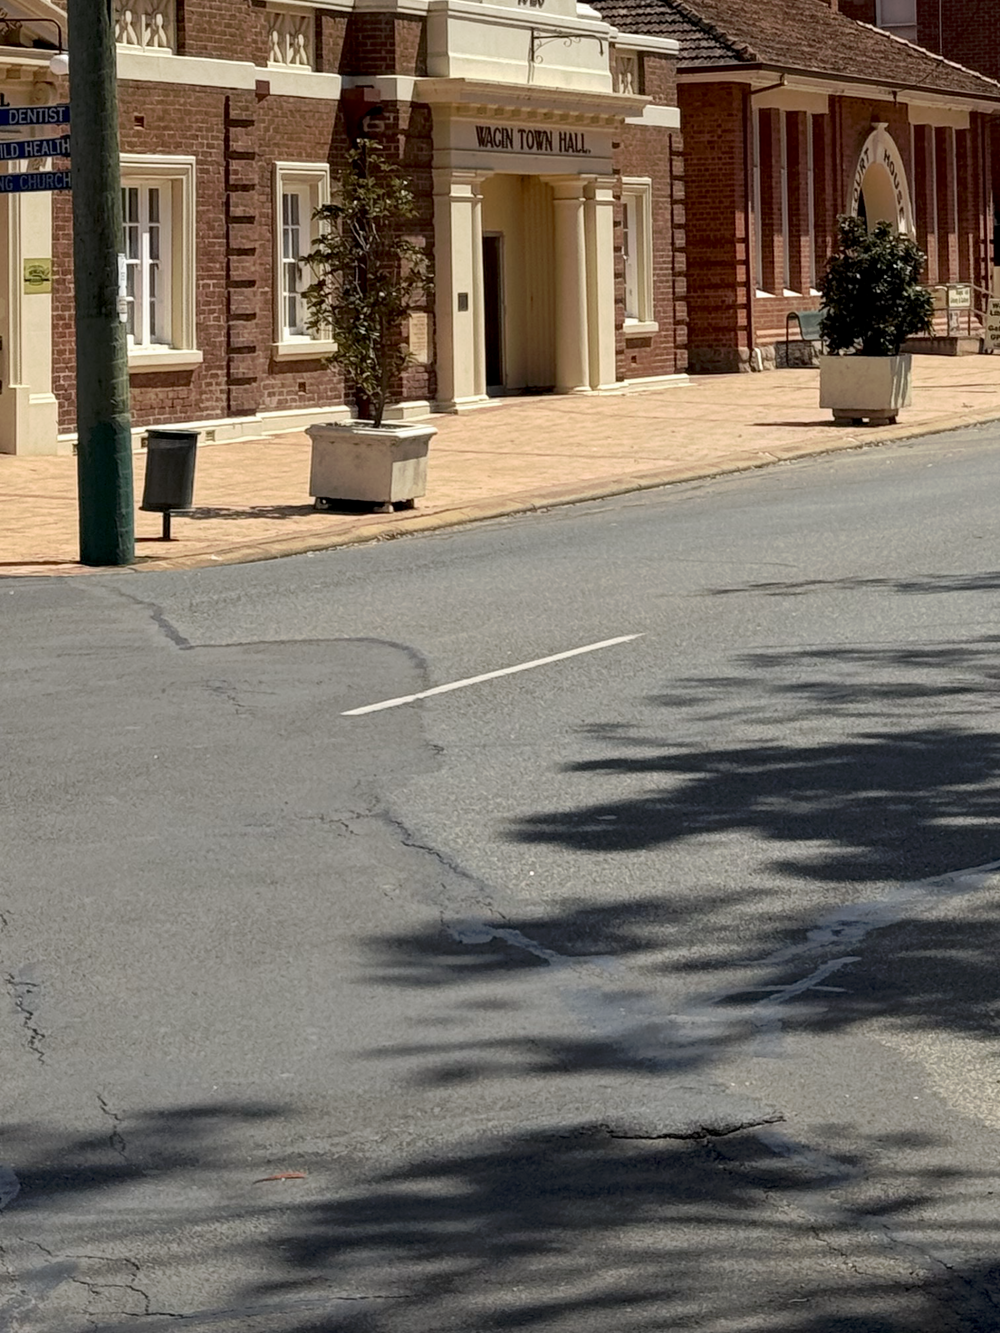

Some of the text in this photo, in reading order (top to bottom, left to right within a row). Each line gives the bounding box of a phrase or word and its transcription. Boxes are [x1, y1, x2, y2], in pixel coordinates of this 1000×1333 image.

[8, 107, 66, 124] DENTIST
[24, 138, 70, 157] HEALTH
[475, 125, 514, 149] WAGIN
[517, 129, 553, 152] TOWN
[20, 172, 71, 190] CHURCH
[852, 147, 869, 212] OURT
